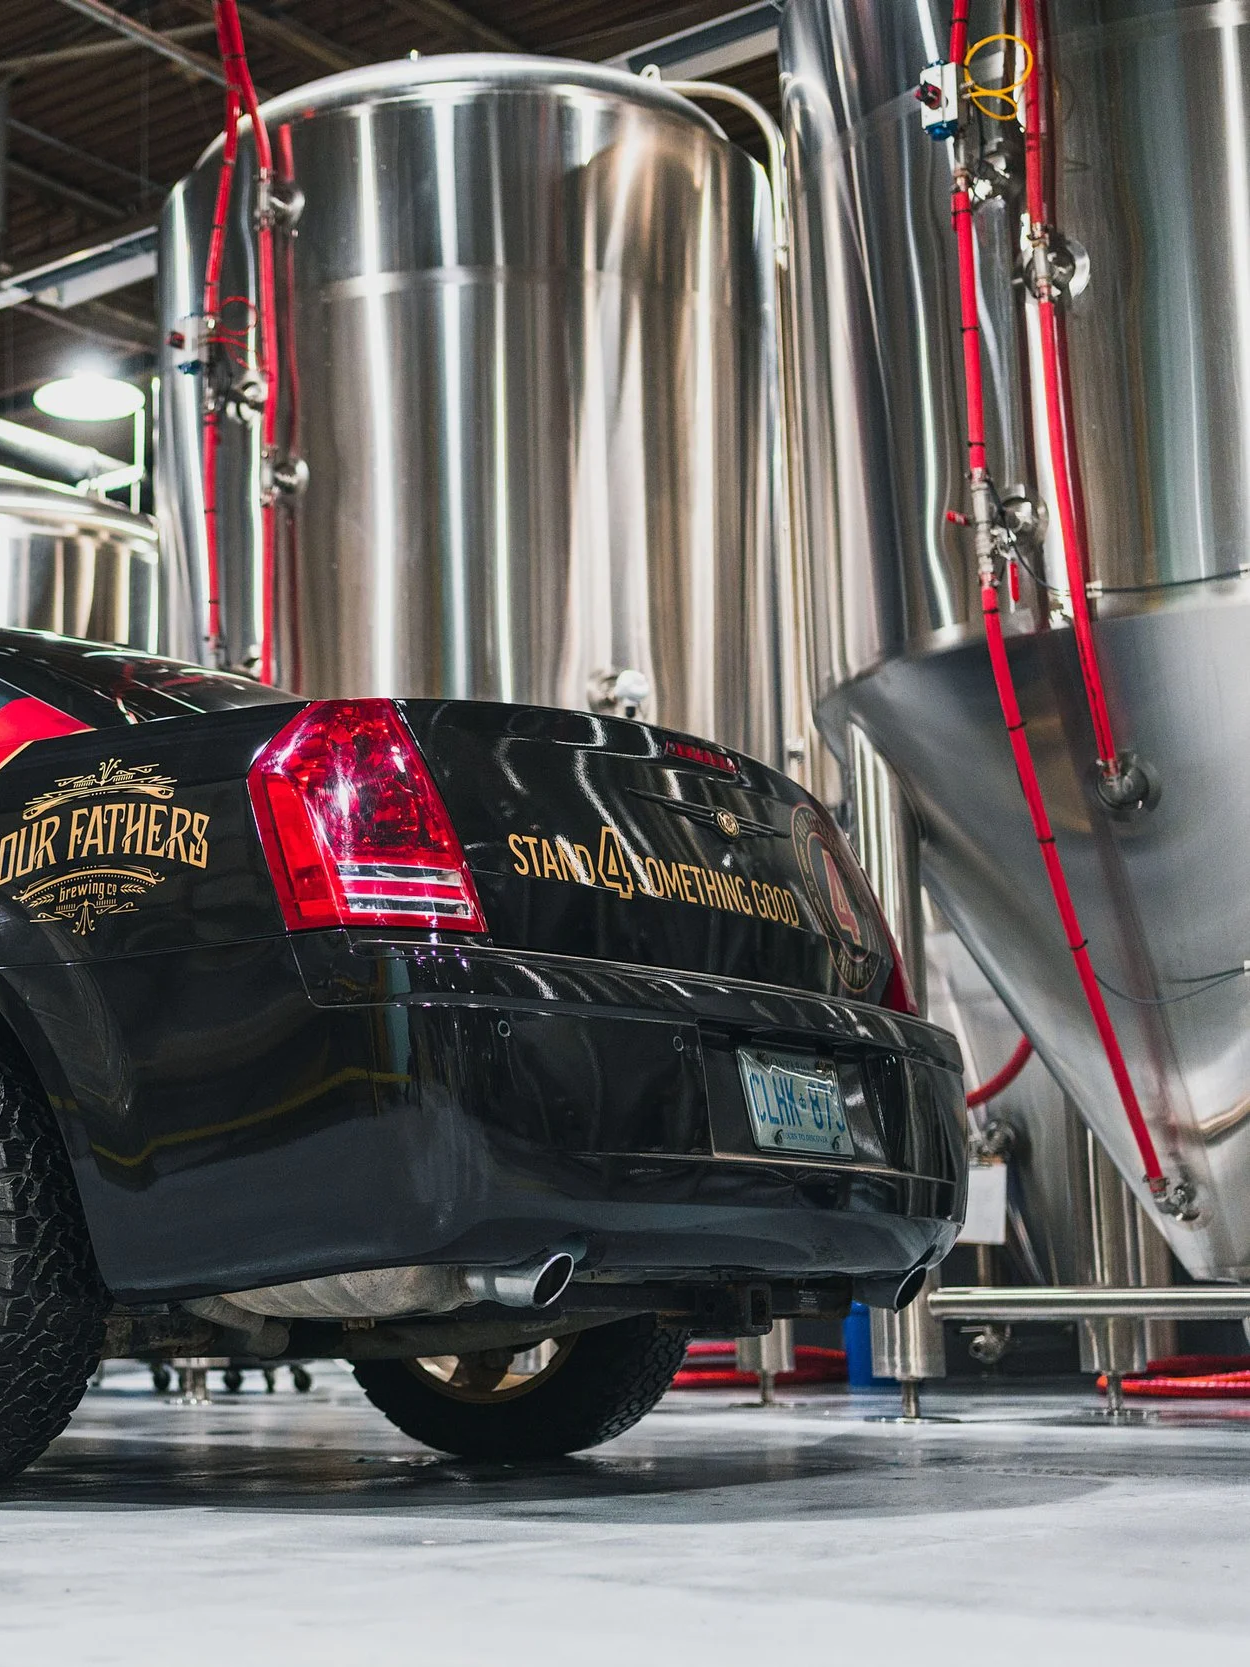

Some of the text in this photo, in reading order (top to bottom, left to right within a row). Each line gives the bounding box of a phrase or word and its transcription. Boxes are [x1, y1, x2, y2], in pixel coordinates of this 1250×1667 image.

[66, 802, 211, 869] FATHERS
[507, 825, 800, 928] STAND 4 SOMETHING GOOD
[58, 879, 105, 903] brewing
[821, 848, 863, 947] 4
